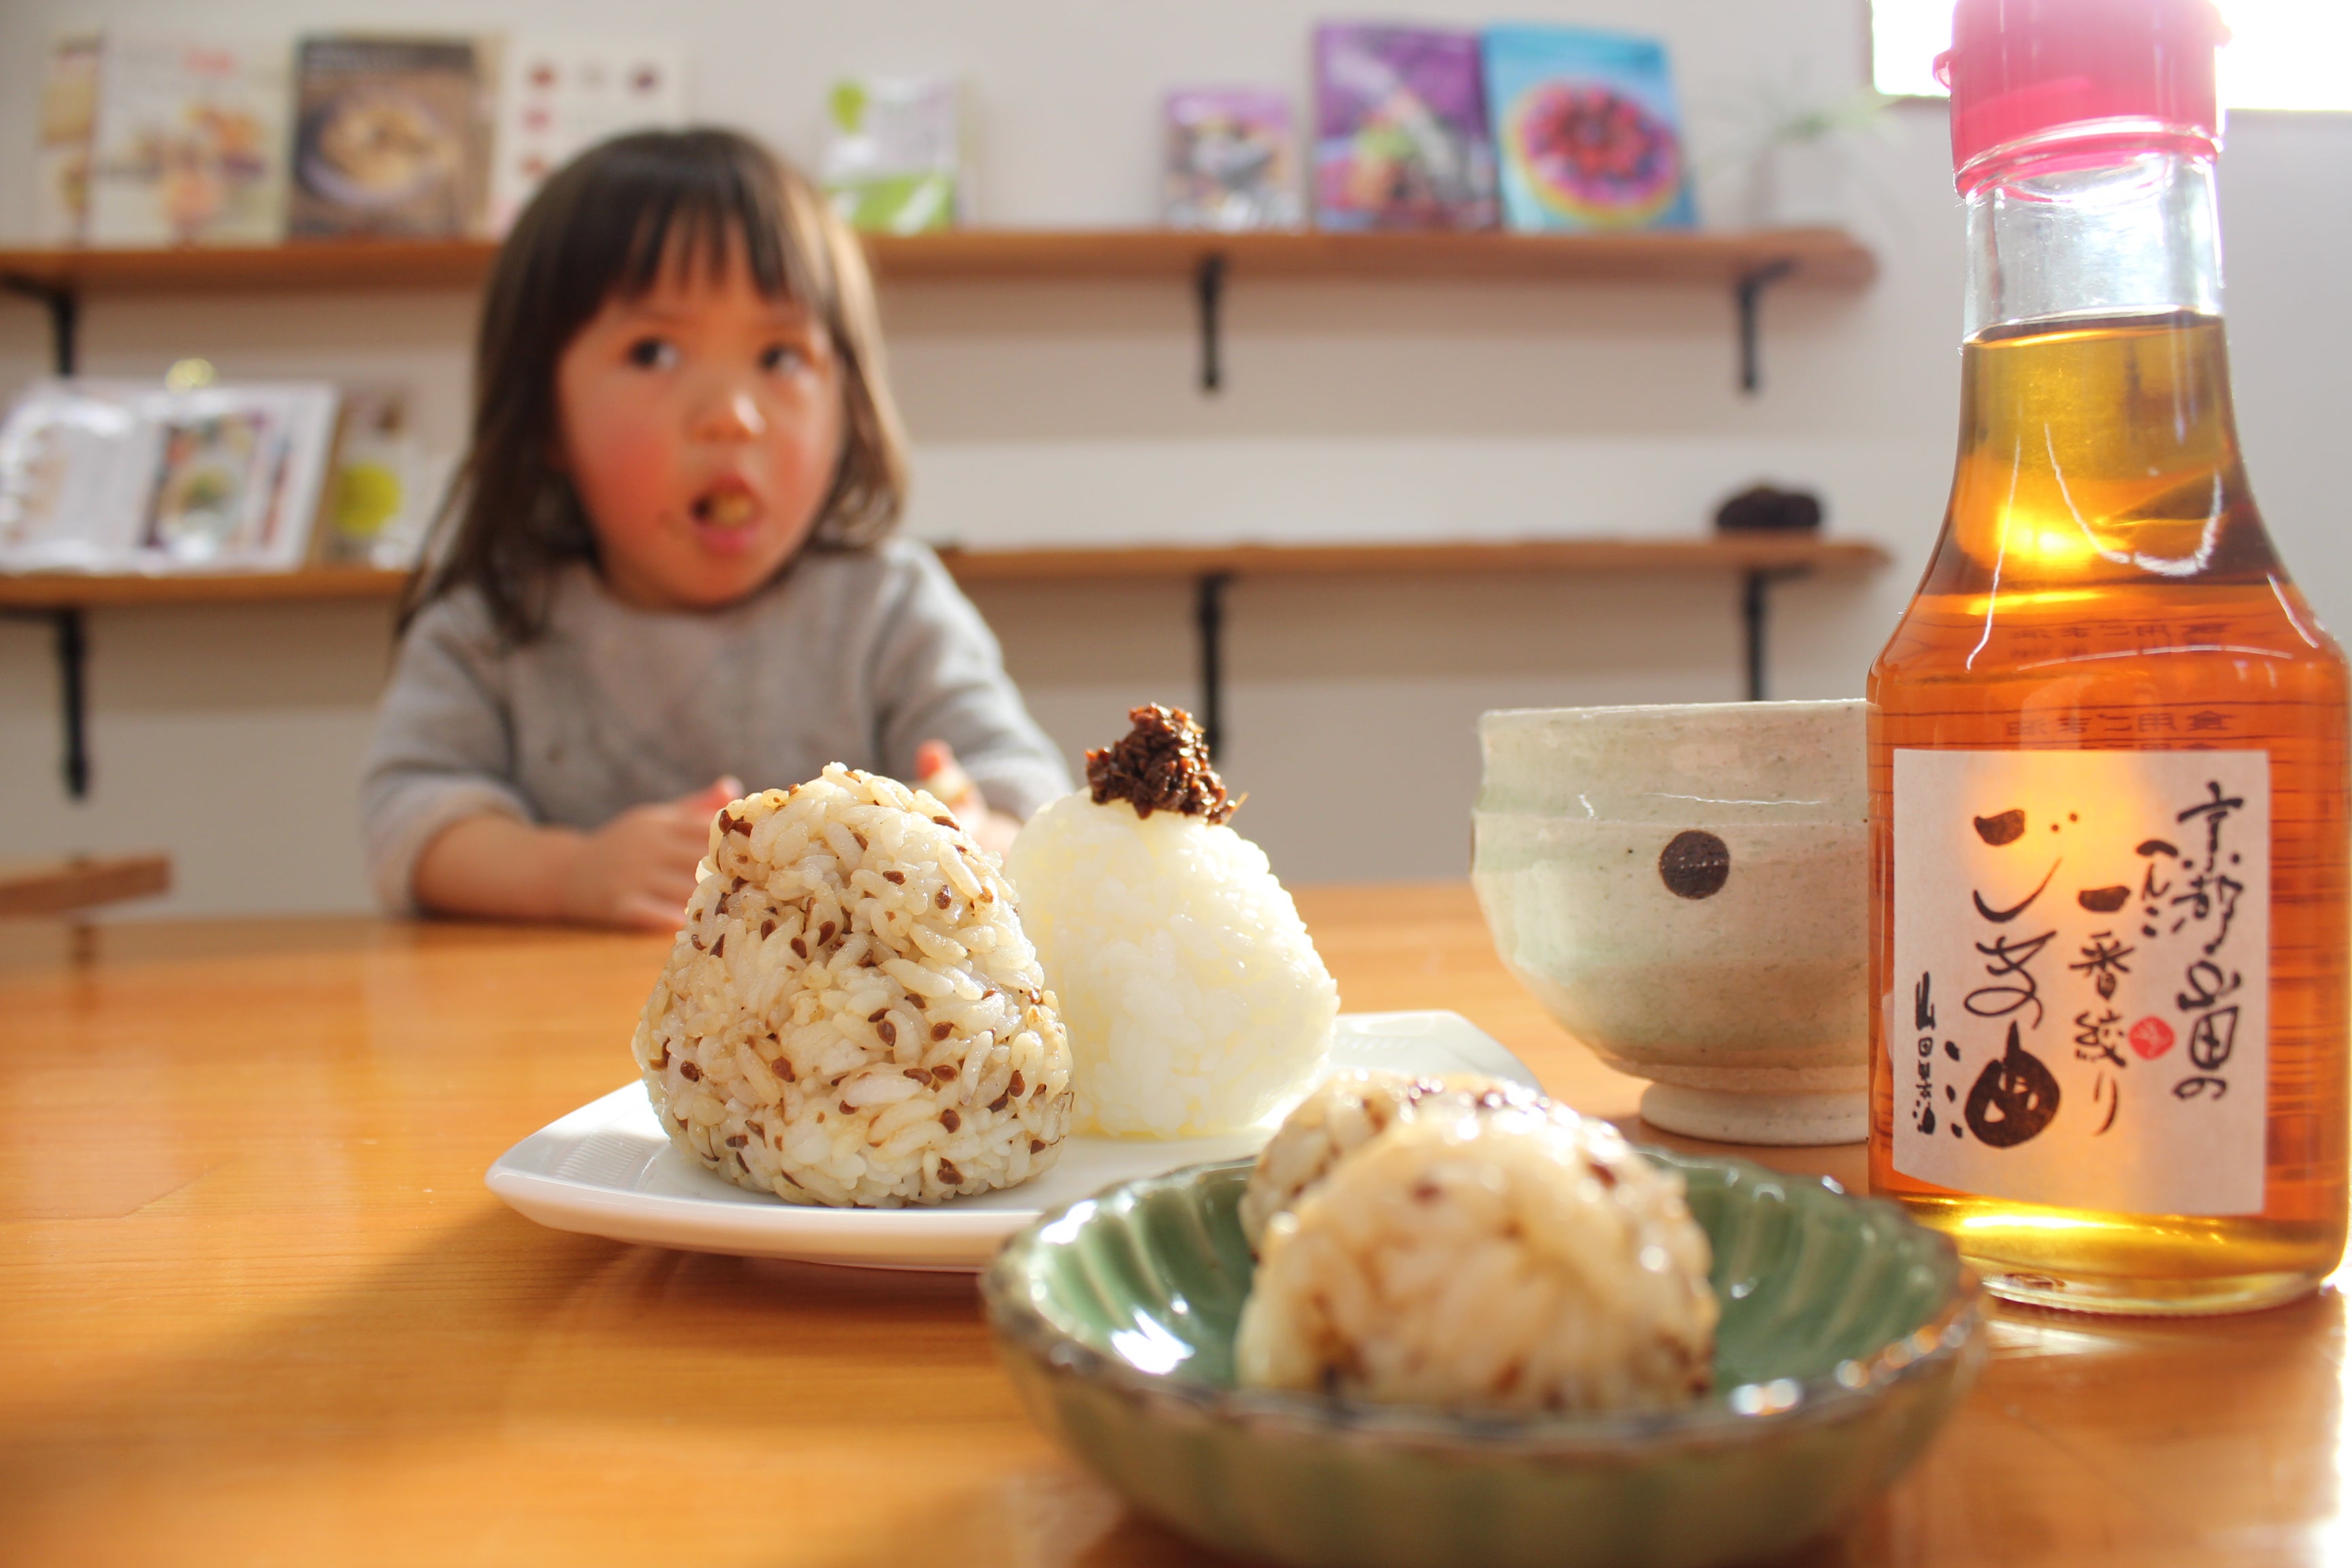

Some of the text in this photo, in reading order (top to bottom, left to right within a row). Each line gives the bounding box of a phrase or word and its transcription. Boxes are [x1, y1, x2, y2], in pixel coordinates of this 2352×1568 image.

[1944, 809, 2077, 1149] ごま油
[2069, 885, 2136, 1136] 一番絞り
